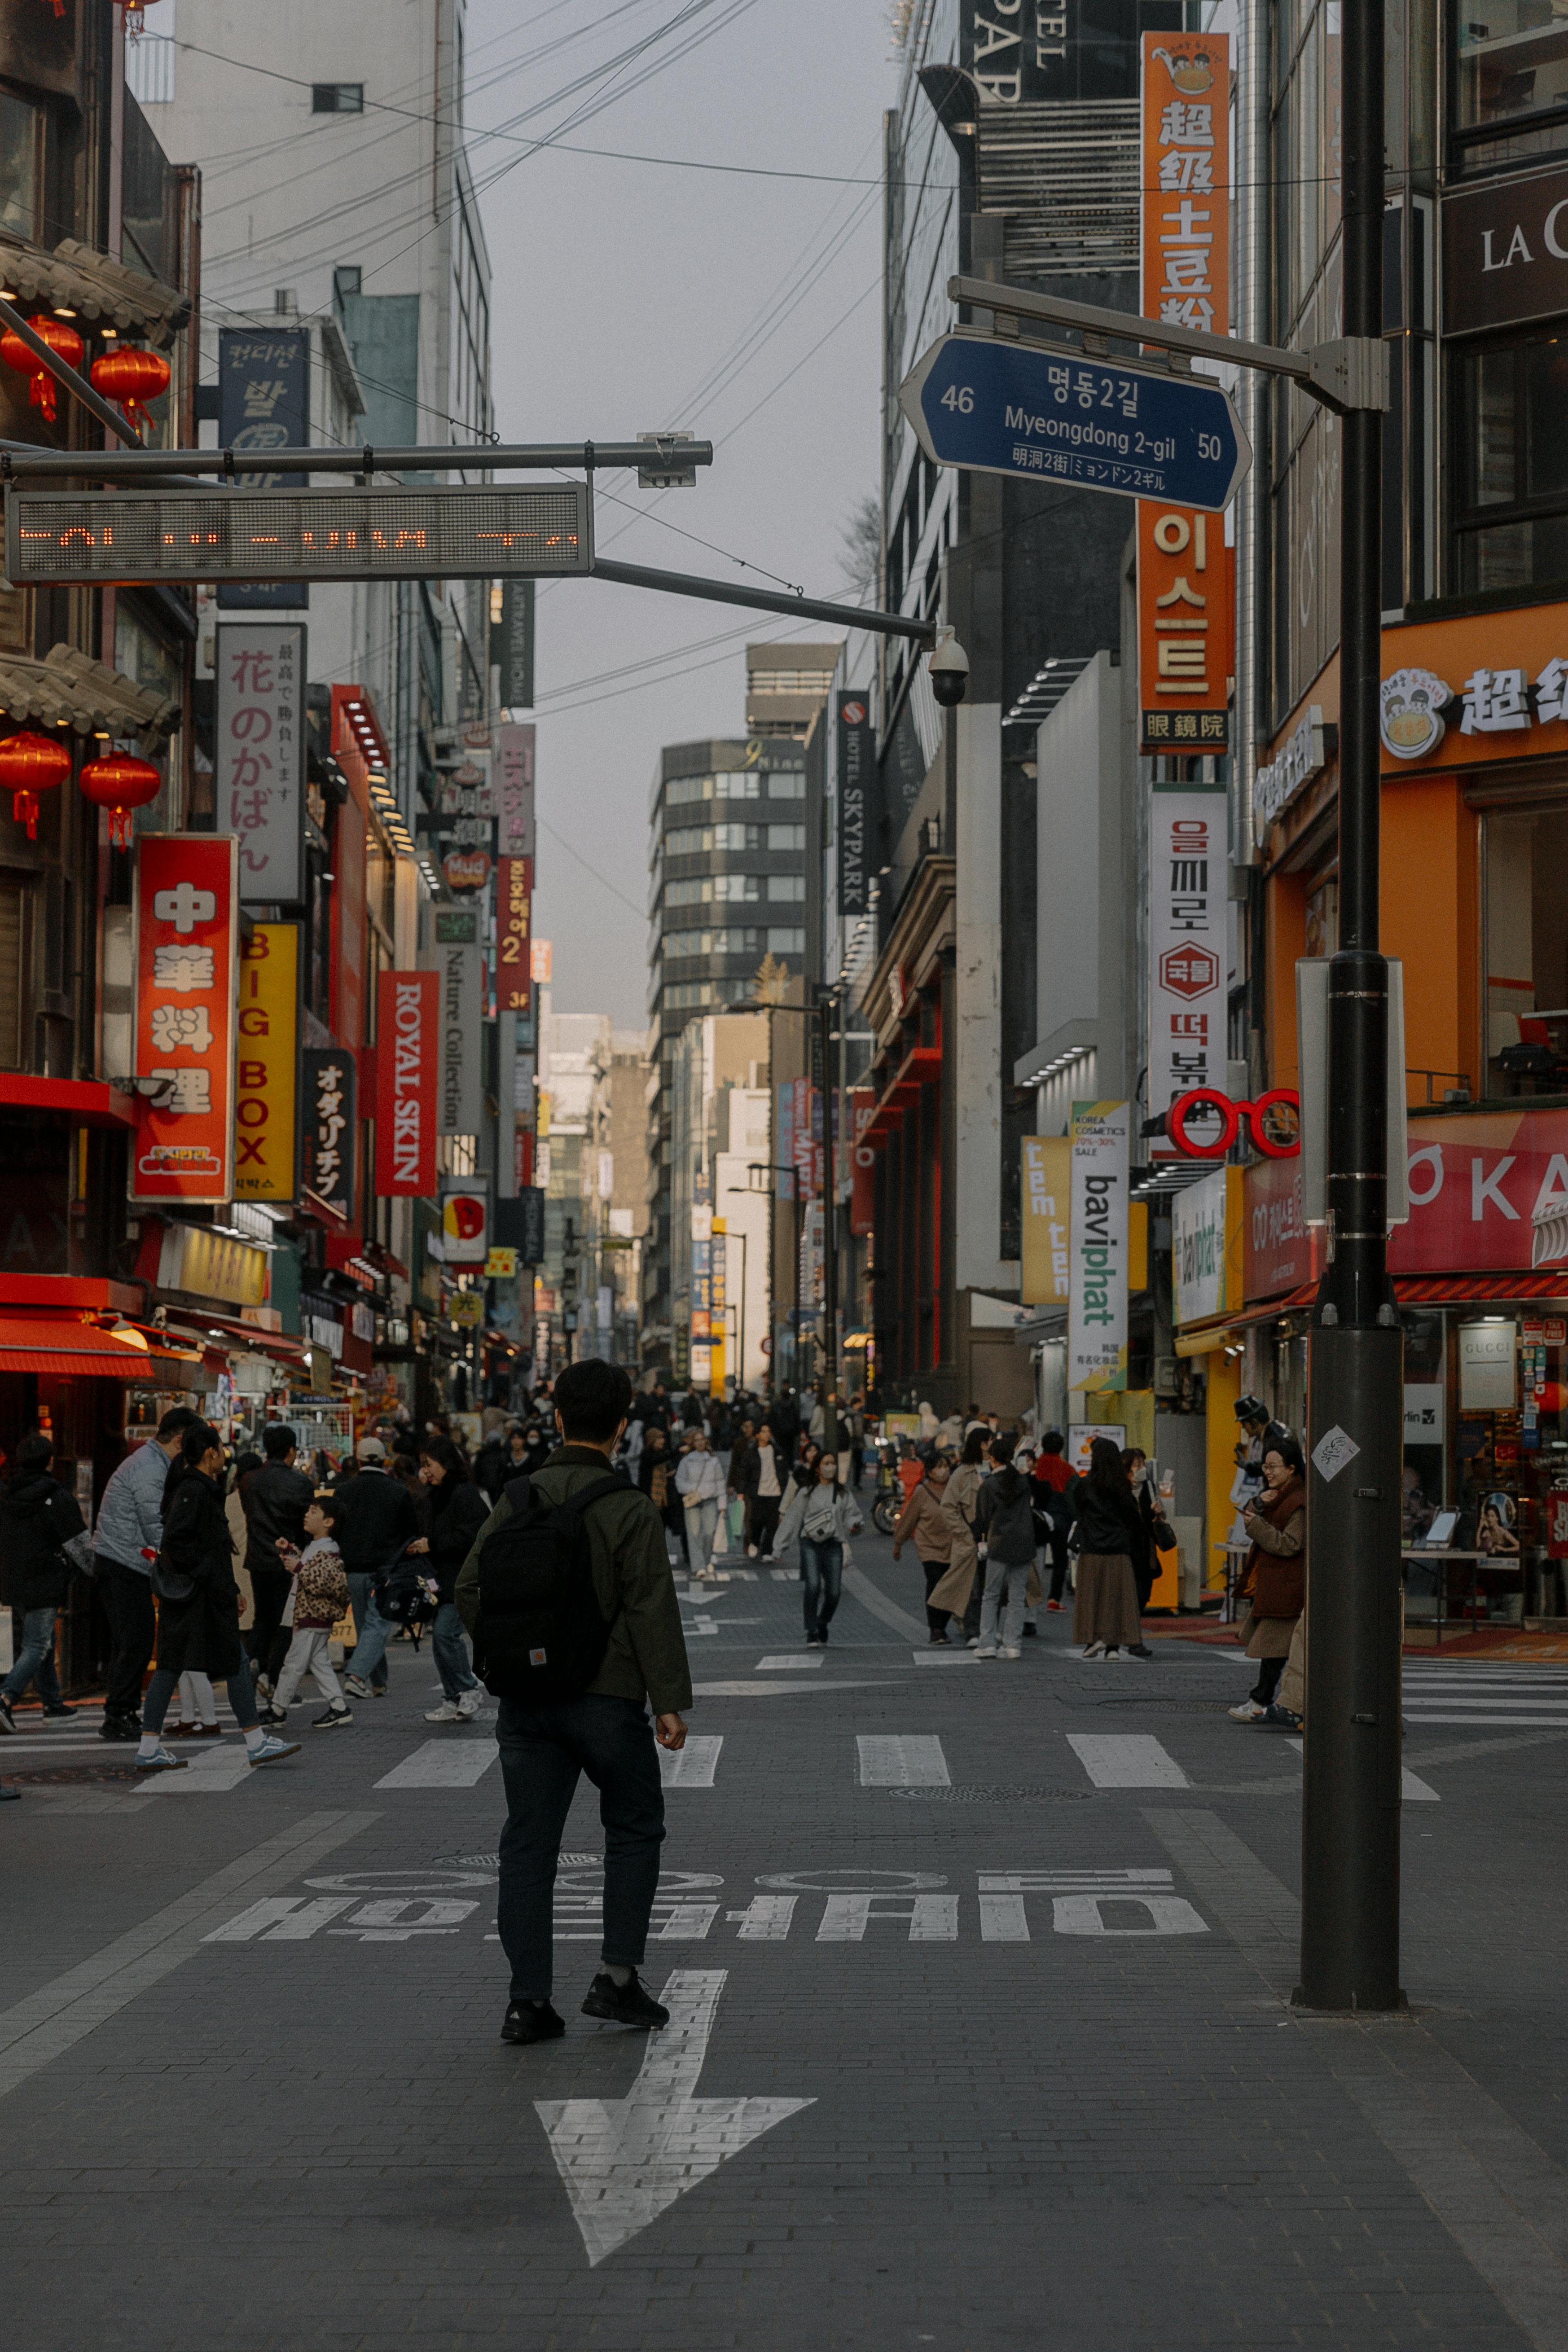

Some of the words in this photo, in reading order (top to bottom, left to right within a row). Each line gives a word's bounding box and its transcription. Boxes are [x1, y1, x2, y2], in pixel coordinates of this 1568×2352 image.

[1481, 224, 1535, 272] LA
[229, 344, 297, 369] 컨디션
[244, 381, 288, 417] 발
[940, 385, 975, 413] 46
[1048, 366, 1138, 418] 명동2길
[1005, 405, 1129, 455] Myeongdong
[1134, 431, 1175, 461] 2-gil
[1198, 432, 1221, 461] 50
[1154, 513, 1209, 693] 이스트
[1147, 715, 1224, 737] 眼鏡院
[847, 730, 861, 785] HOTEL
[844, 788, 864, 906] SKYPARK
[502, 936, 520, 963] 2
[238, 932, 270, 1036] BIG
[445, 950, 463, 1020] Nature
[509, 991, 529, 1008] 3F
[395, 982, 422, 1094] ROYAL
[445, 1028, 463, 1127] Collection
[237, 1061, 269, 1165] BOX
[1075, 1127, 1125, 1136] COSMETICS
[1076, 1116, 1105, 1124] KOREA
[393, 1099, 420, 1184] SKIN
[1075, 1148, 1097, 1156] SALE
[1083, 1175, 1117, 1326] baviphat
[1466, 1342, 1510, 1354] GUCCI
